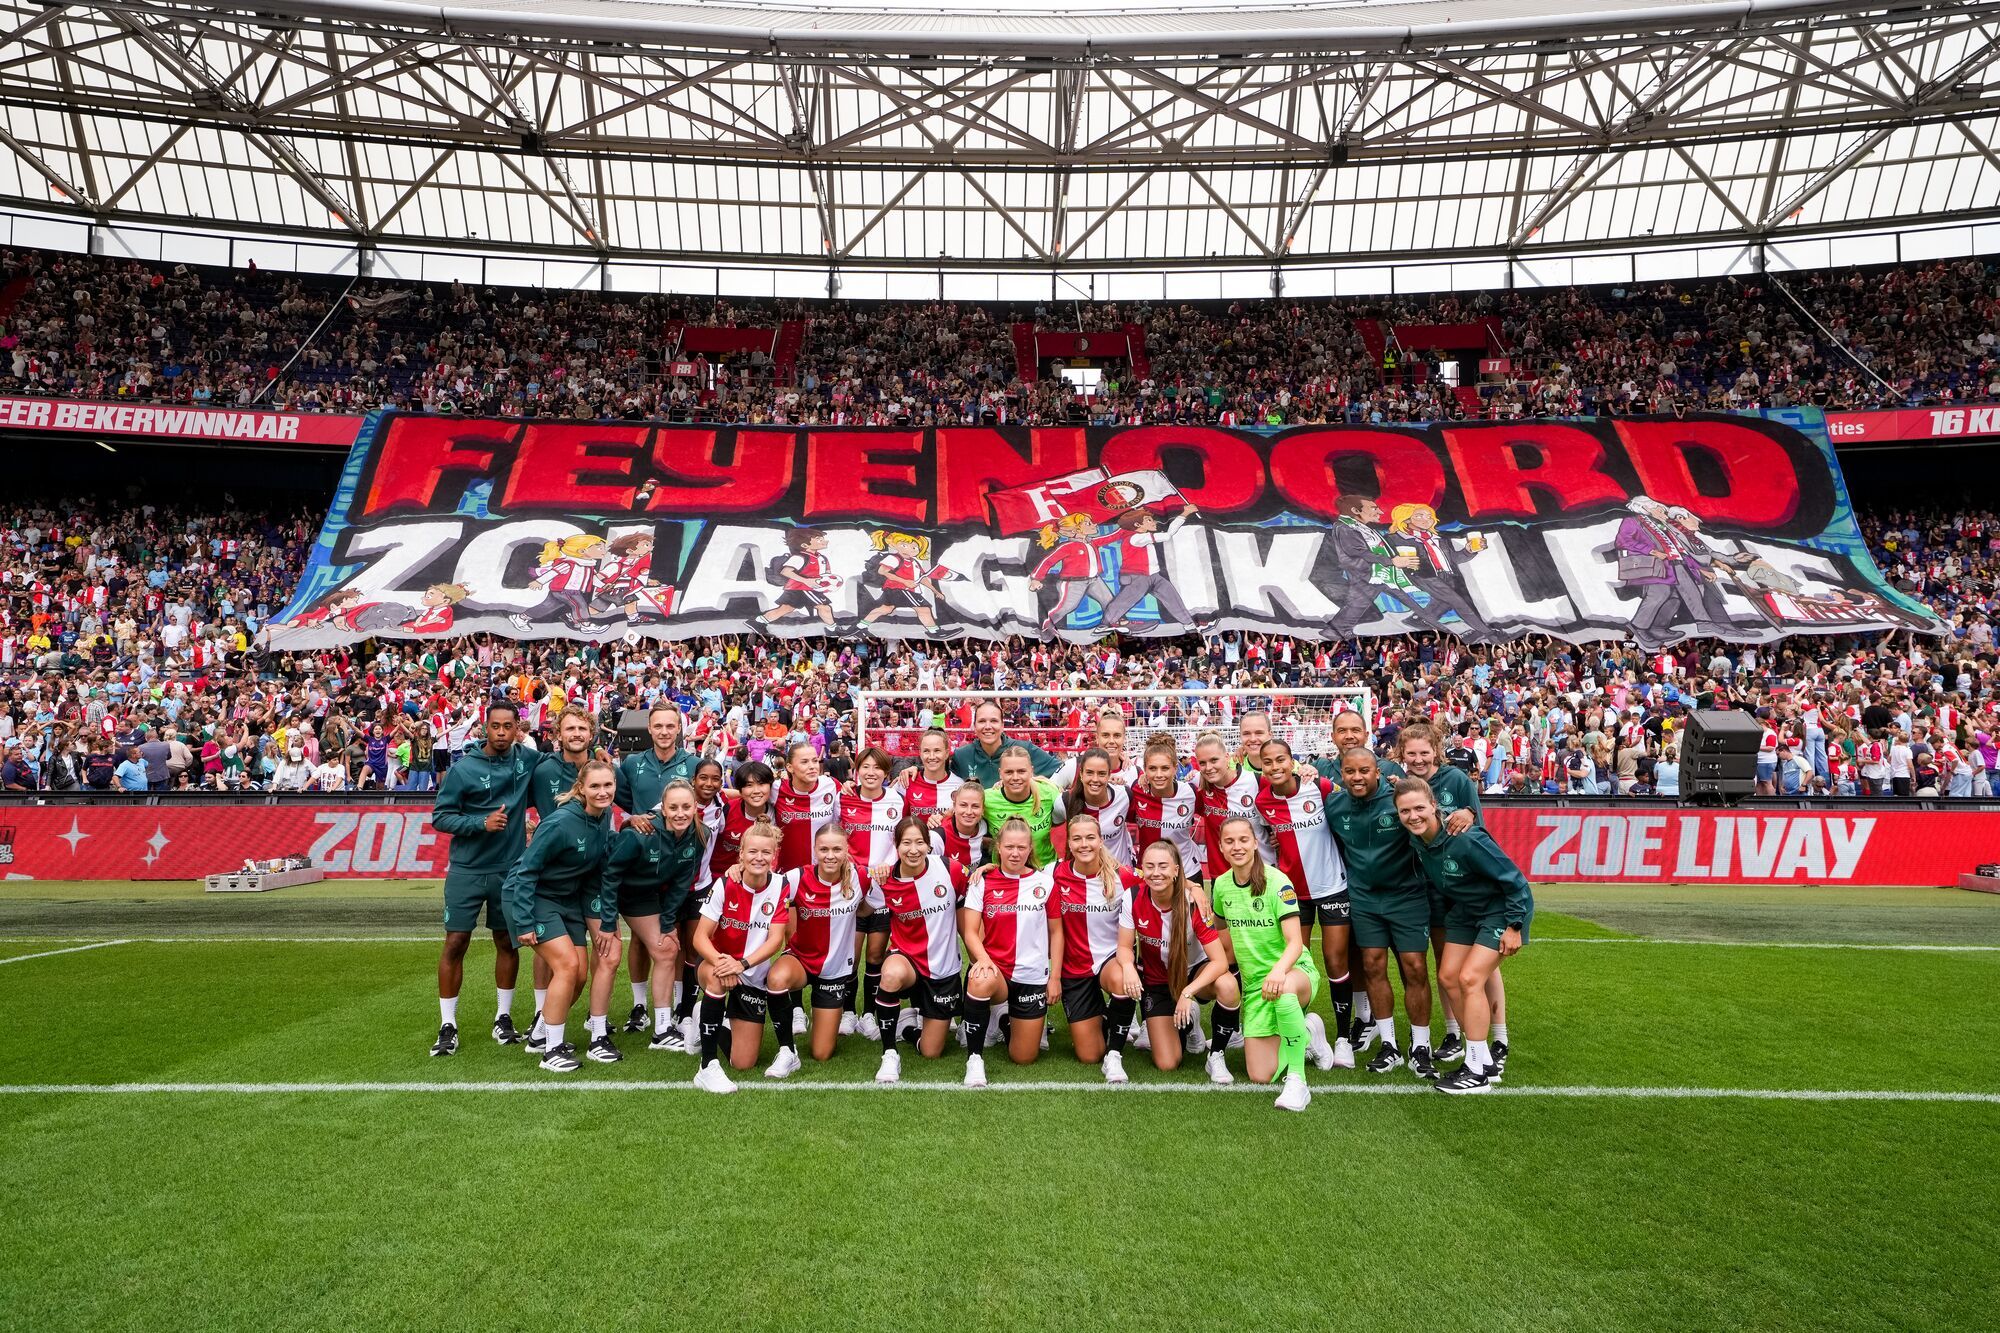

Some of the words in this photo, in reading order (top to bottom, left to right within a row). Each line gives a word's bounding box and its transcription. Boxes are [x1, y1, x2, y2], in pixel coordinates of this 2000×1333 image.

[676, 364, 693, 375] RR
[1488, 360, 1502, 371] TT
[53, 403, 300, 439] BEKERWINNAAR
[1930, 409, 1965, 436] 16
[363, 416, 1796, 528] FEYENOORD
[1163, 523, 1342, 622] IK
[303, 811, 437, 873] ZOE
[1530, 814, 1667, 877] ZOE
[1672, 815, 1878, 879] LIVAY
[1227, 918, 1275, 930] TERMINALS
[703, 1022, 719, 1035] F
[879, 1018, 895, 1030] F
[964, 1020, 981, 1034] F
[1116, 1024, 1131, 1035] F
[1217, 1024, 1234, 1036] F
